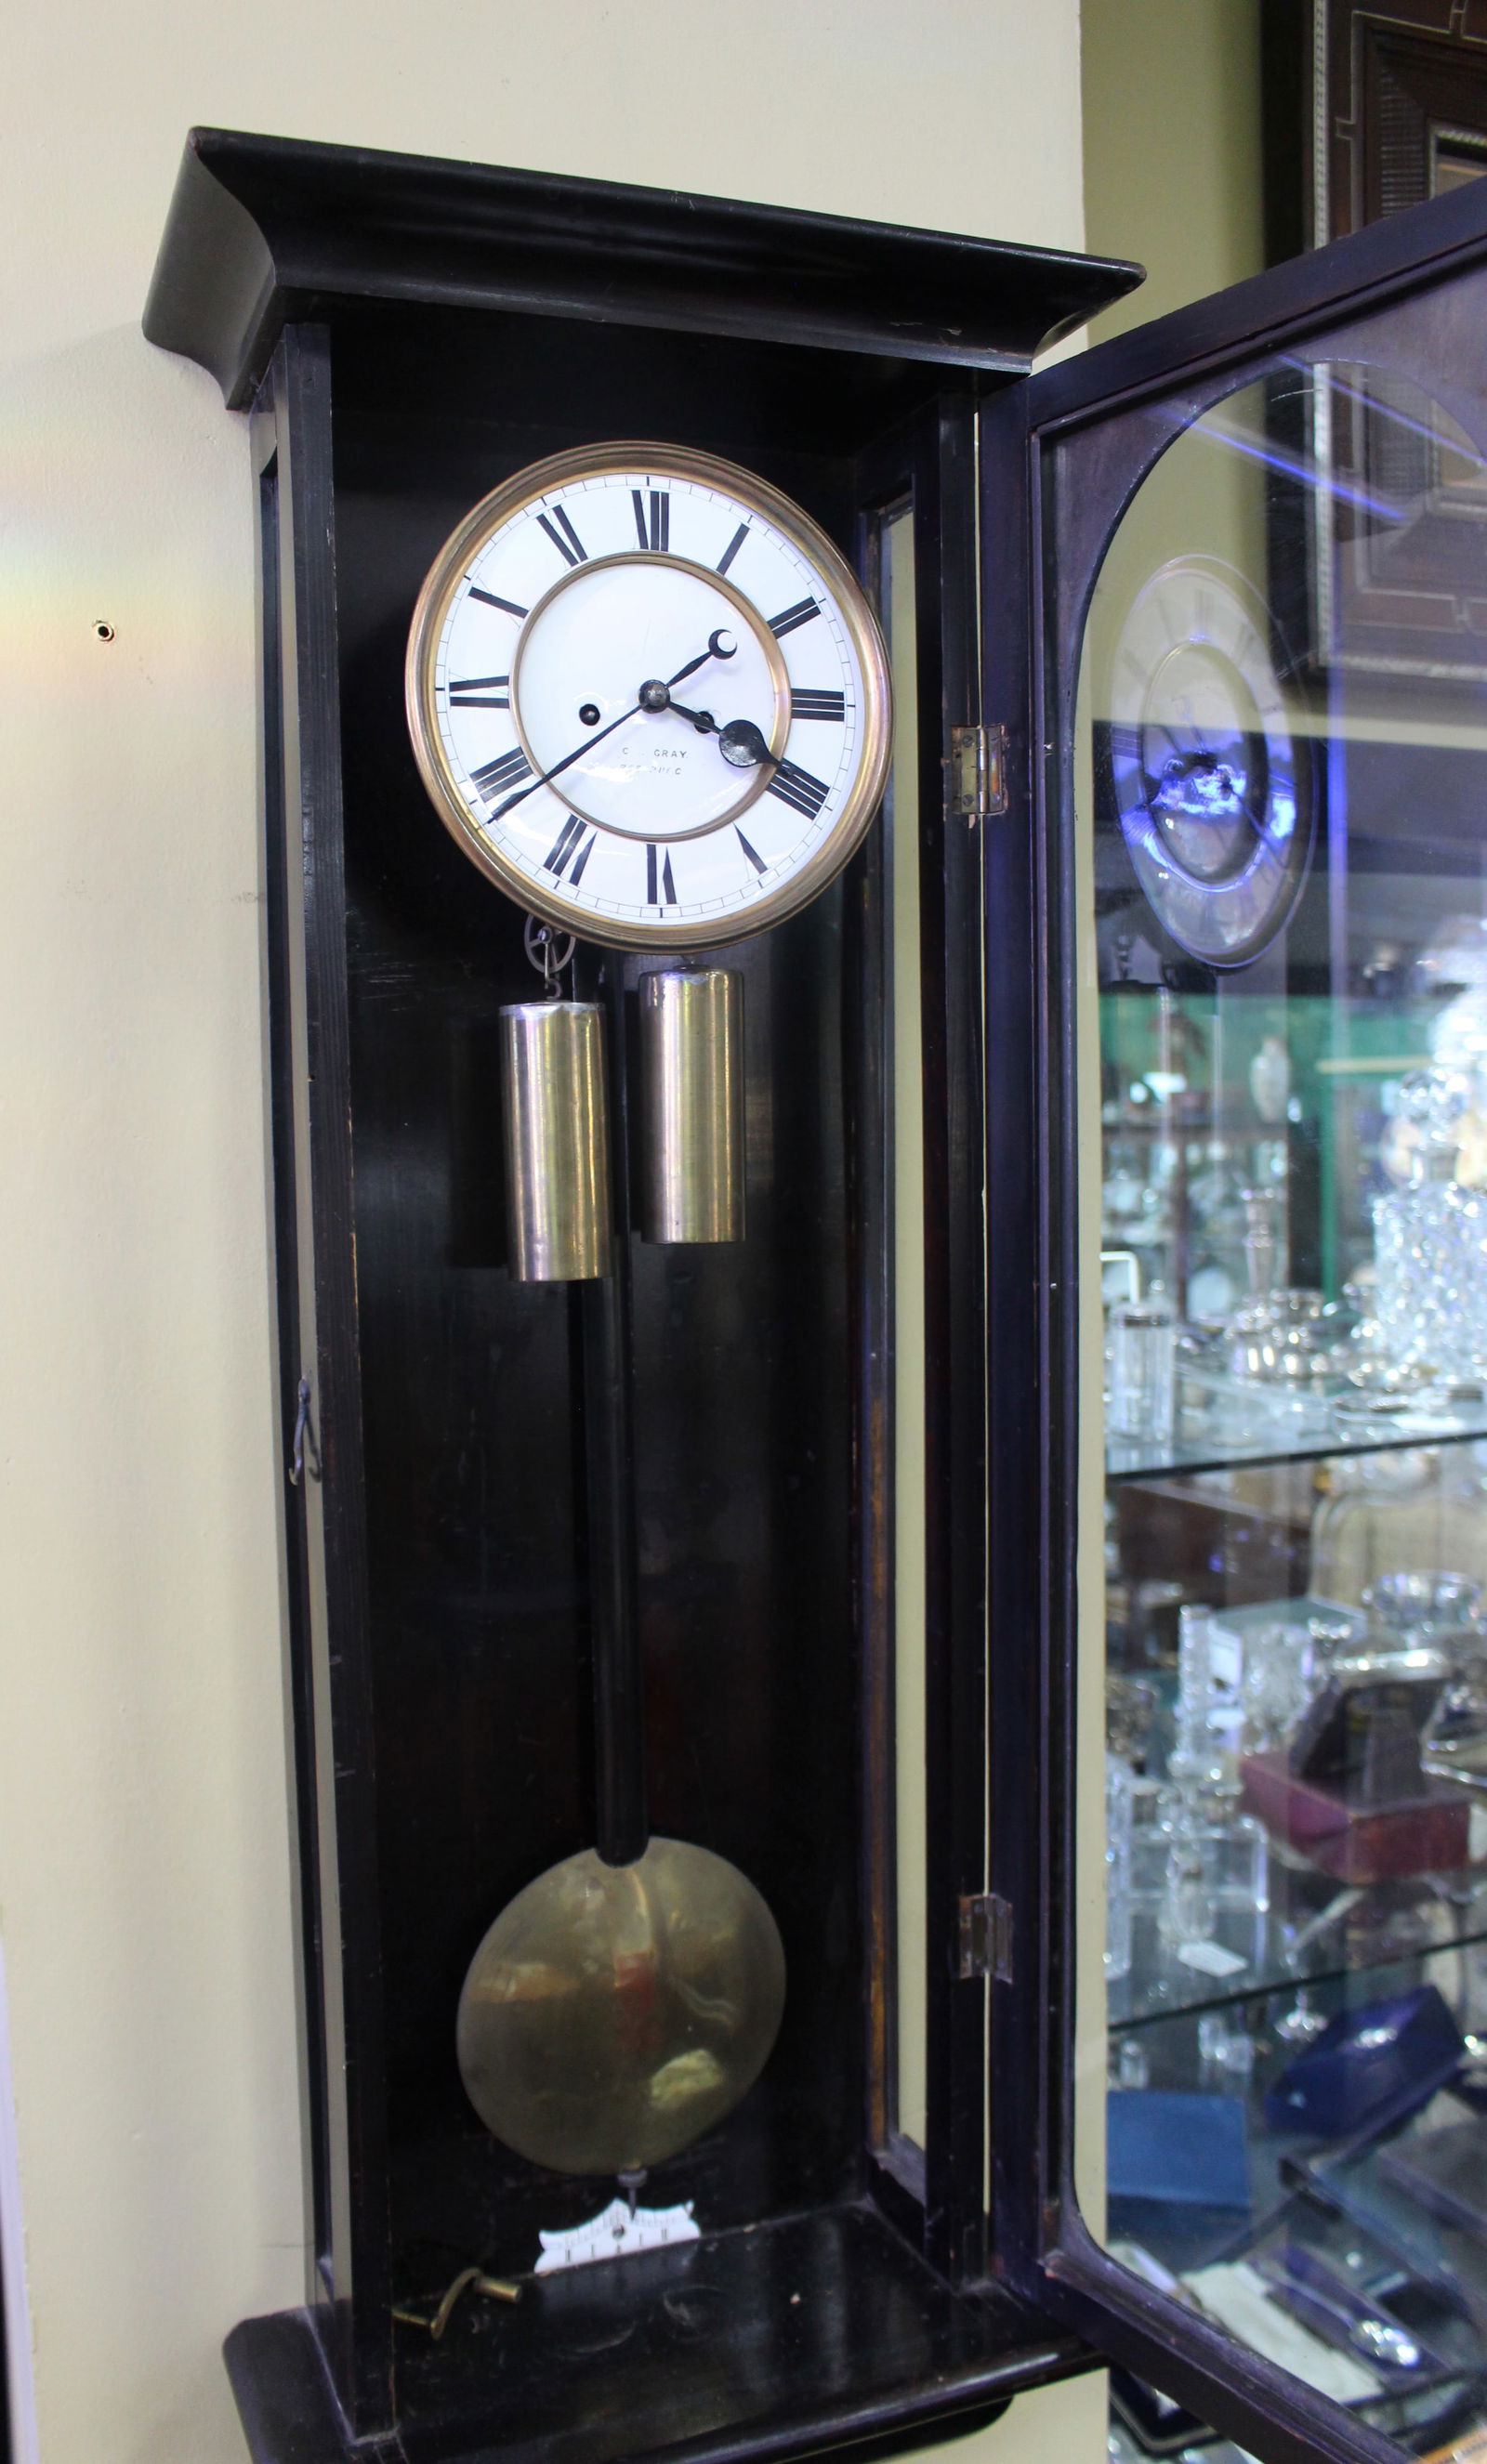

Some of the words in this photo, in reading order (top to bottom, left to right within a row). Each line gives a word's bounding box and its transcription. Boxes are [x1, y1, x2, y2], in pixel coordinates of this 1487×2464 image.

[534, 504, 589, 573] XI
[631, 490, 670, 553] XII
[716, 523, 751, 576] I
[467, 574, 530, 628] X
[766, 596, 823, 641] II
[448, 672, 511, 710] IX
[789, 688, 846, 723] III
[765, 757, 831, 820] IIII
[543, 813, 599, 888] VII
[646, 843, 678, 906] VI
[733, 822, 770, 883] V
